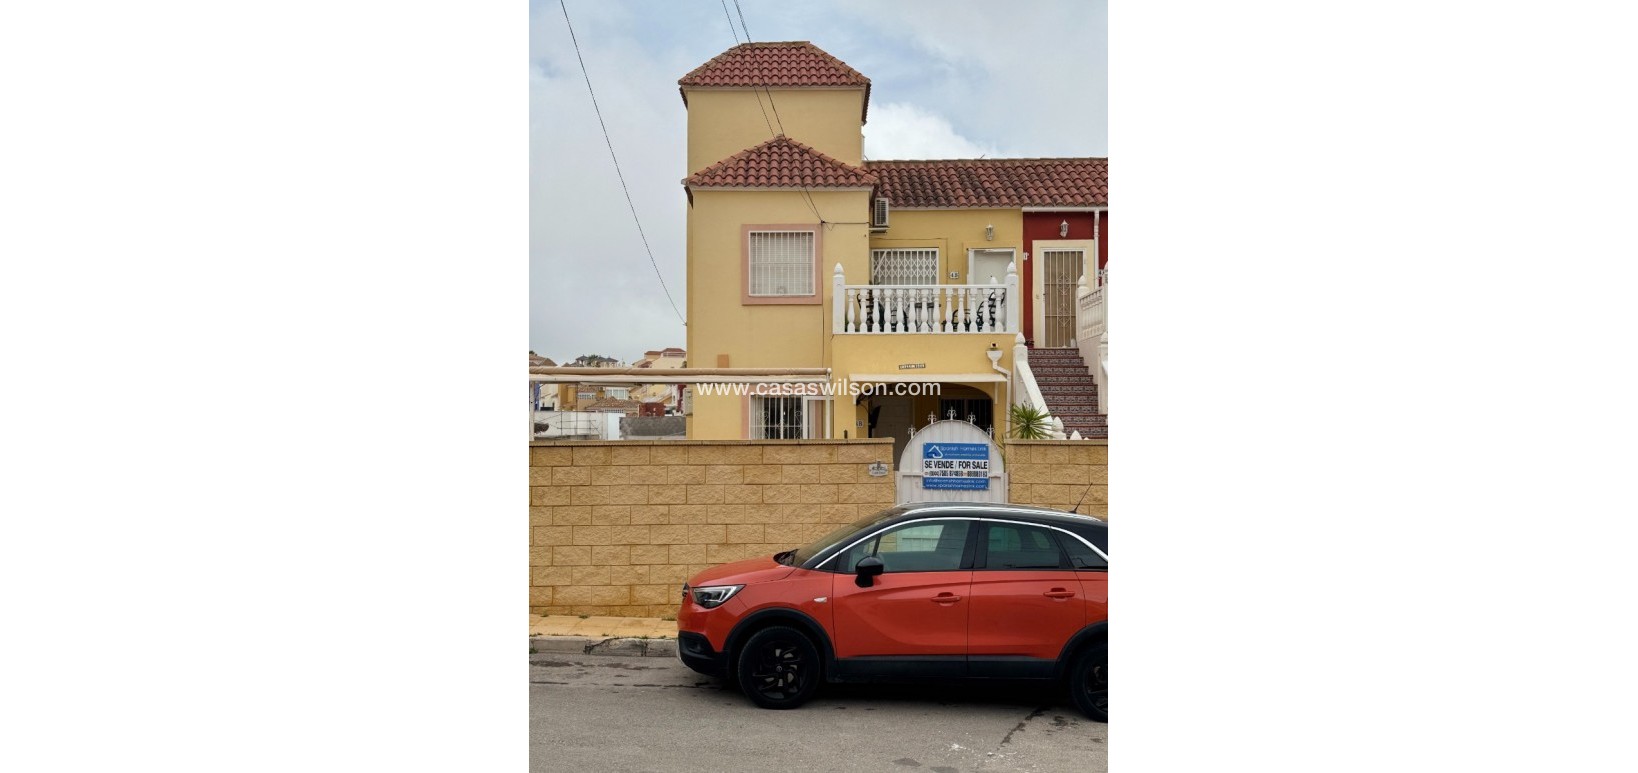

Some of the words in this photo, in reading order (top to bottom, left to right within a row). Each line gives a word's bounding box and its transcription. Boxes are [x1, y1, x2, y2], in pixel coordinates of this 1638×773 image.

[924, 460, 932, 469] SE
[933, 460, 954, 469] VENDE
[958, 461, 971, 469] FOR
[972, 461, 988, 470] SALE
